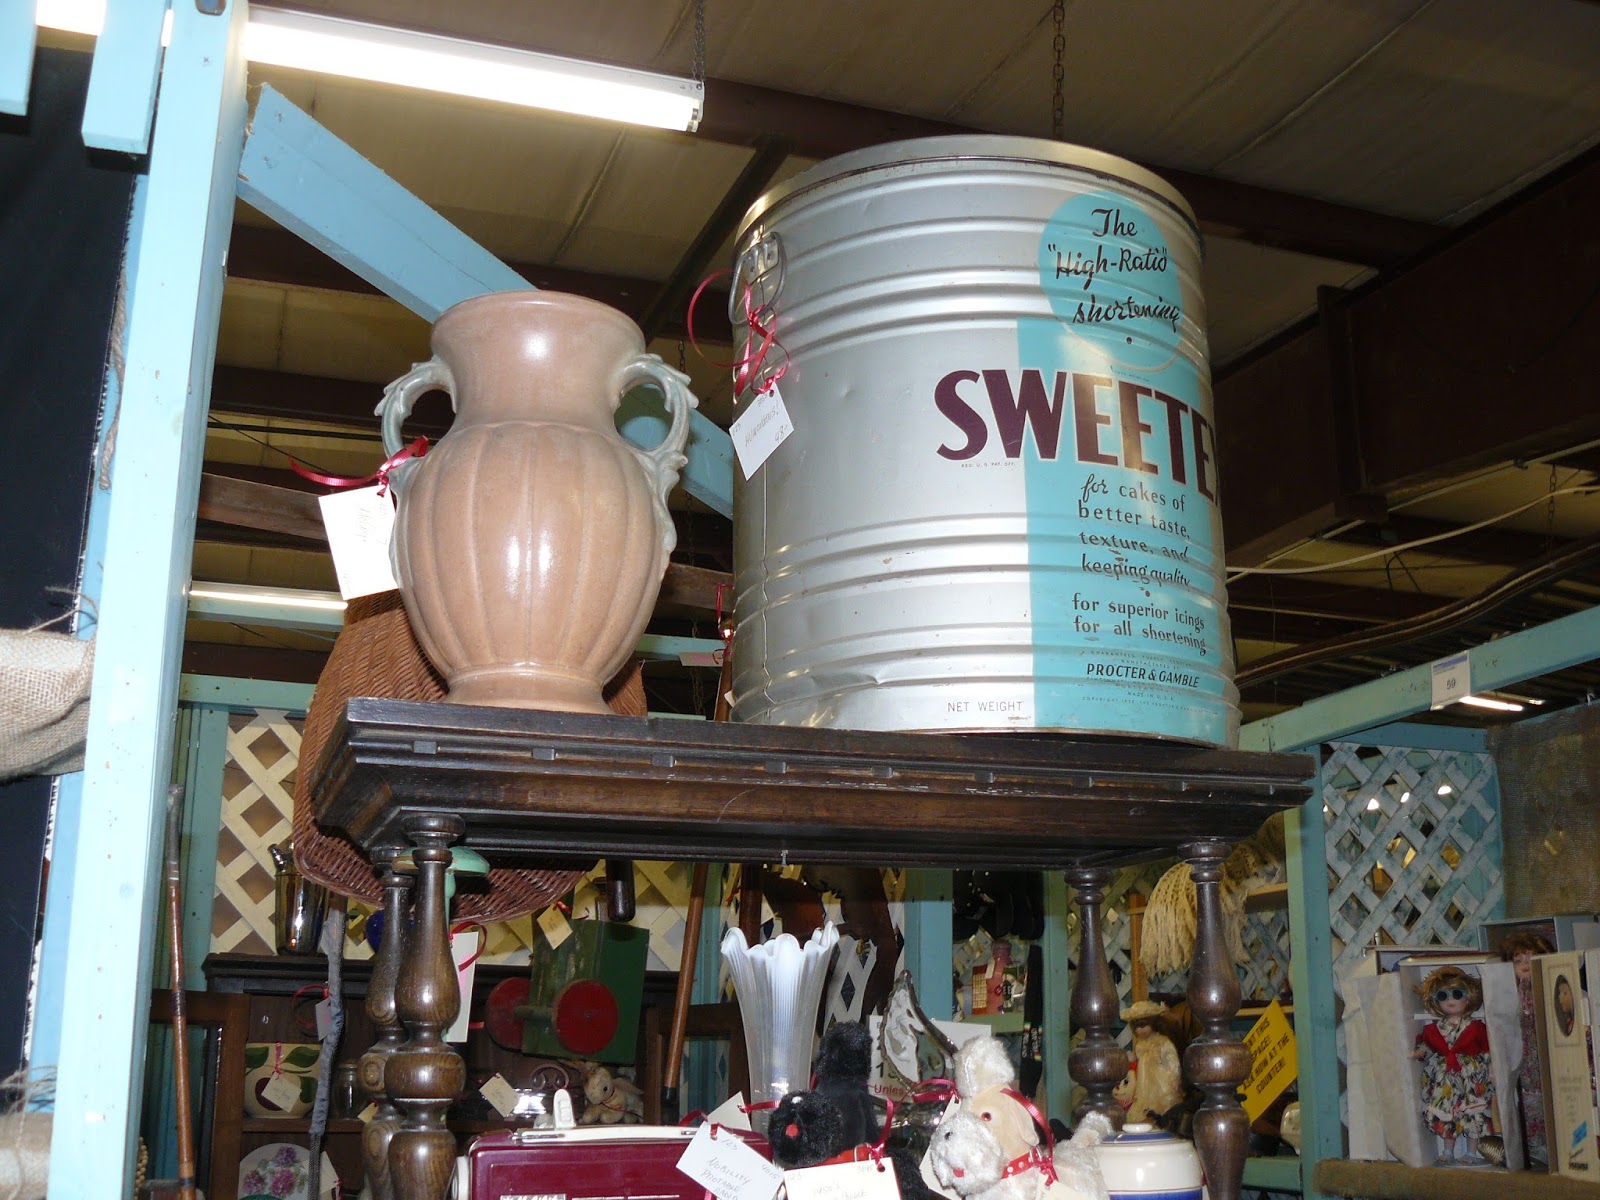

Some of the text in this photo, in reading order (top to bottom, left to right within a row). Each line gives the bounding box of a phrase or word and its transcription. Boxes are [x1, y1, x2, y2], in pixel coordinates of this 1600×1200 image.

[1091, 208, 1138, 238] The
[1072, 294, 1181, 333] shortening
[933, 368, 1219, 506] SWEETE
[1081, 473, 1186, 512] for cakes of
[1078, 499, 1142, 526] better
[1079, 531, 1189, 563] texture, and
[1081, 553, 1150, 585] keeping
[1072, 592, 1205, 634] for superior icings
[1073, 615, 1207, 656] for all shortening
[1086, 663, 1146, 680] PROCTER
[1148, 669, 1157, 681] &
[1158, 670, 1200, 688] GAMBLE
[947, 700, 1024, 713] NET WEIGHT
